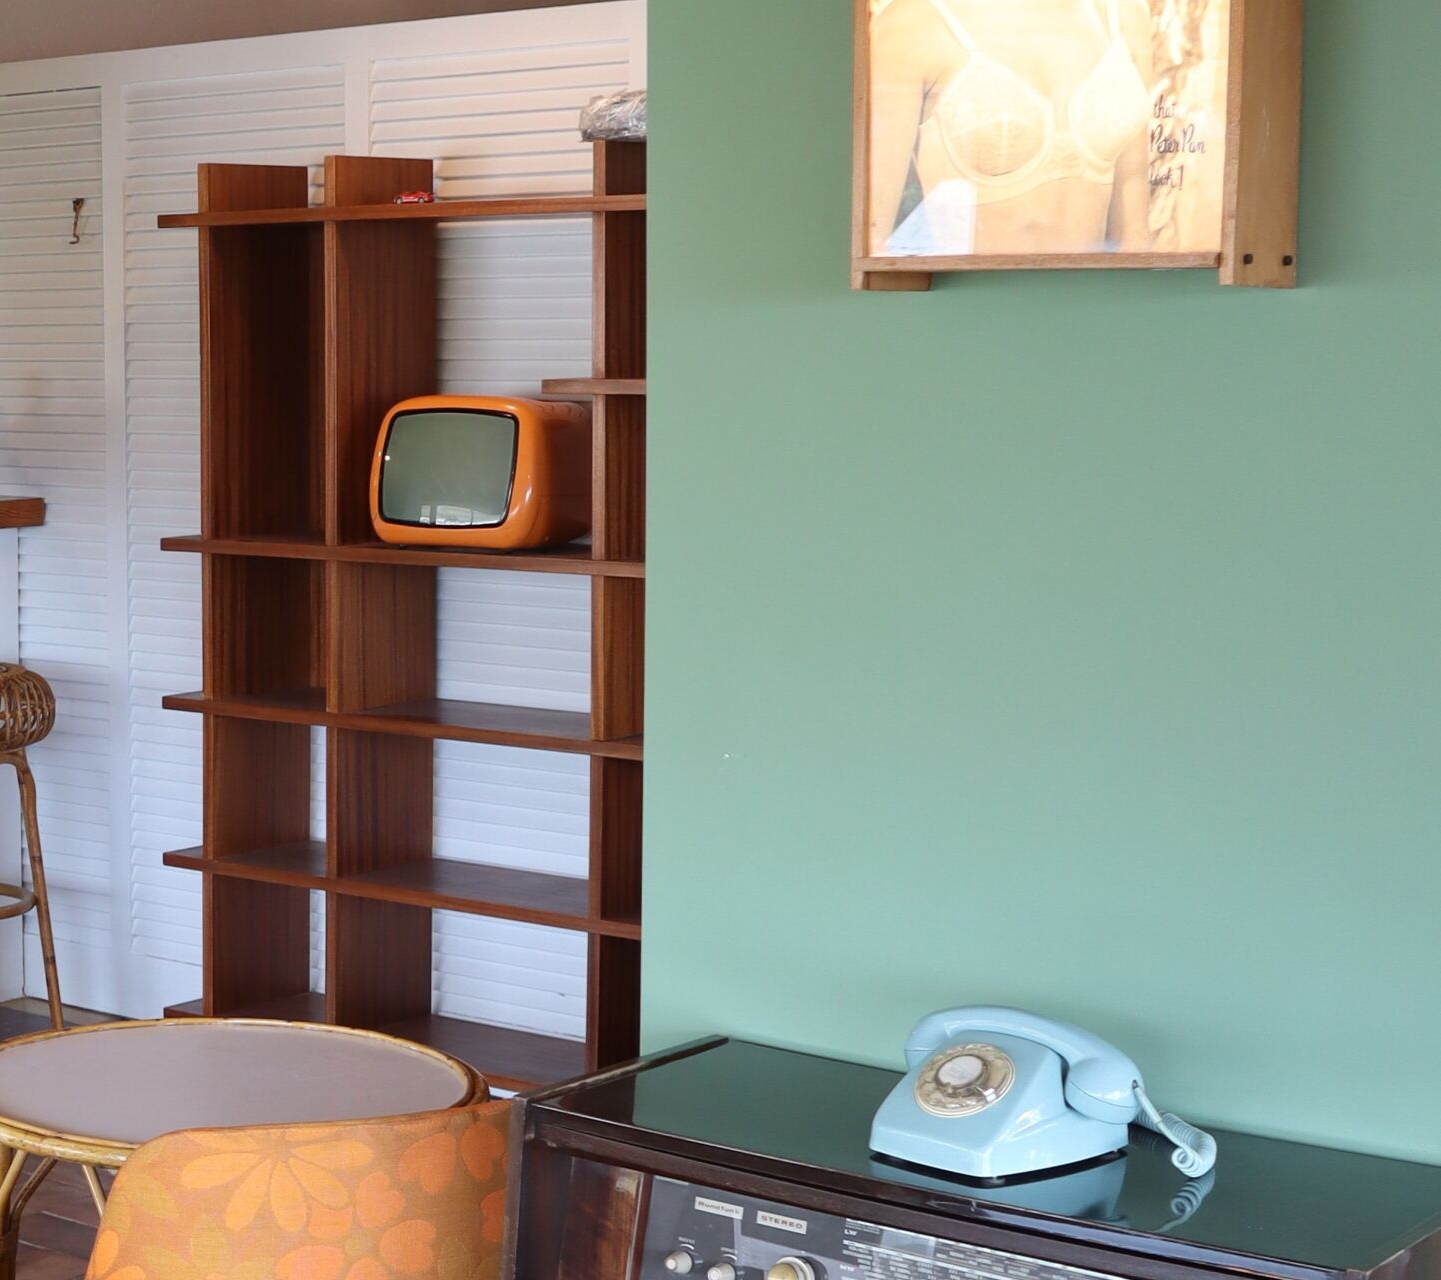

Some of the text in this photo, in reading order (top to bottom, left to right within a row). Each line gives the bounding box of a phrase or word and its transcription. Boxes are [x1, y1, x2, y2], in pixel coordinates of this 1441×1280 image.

[1150, 123, 1206, 154] Peter Pan
[761, 1215, 803, 1230] STEREO
[844, 1228, 858, 1236] LW
